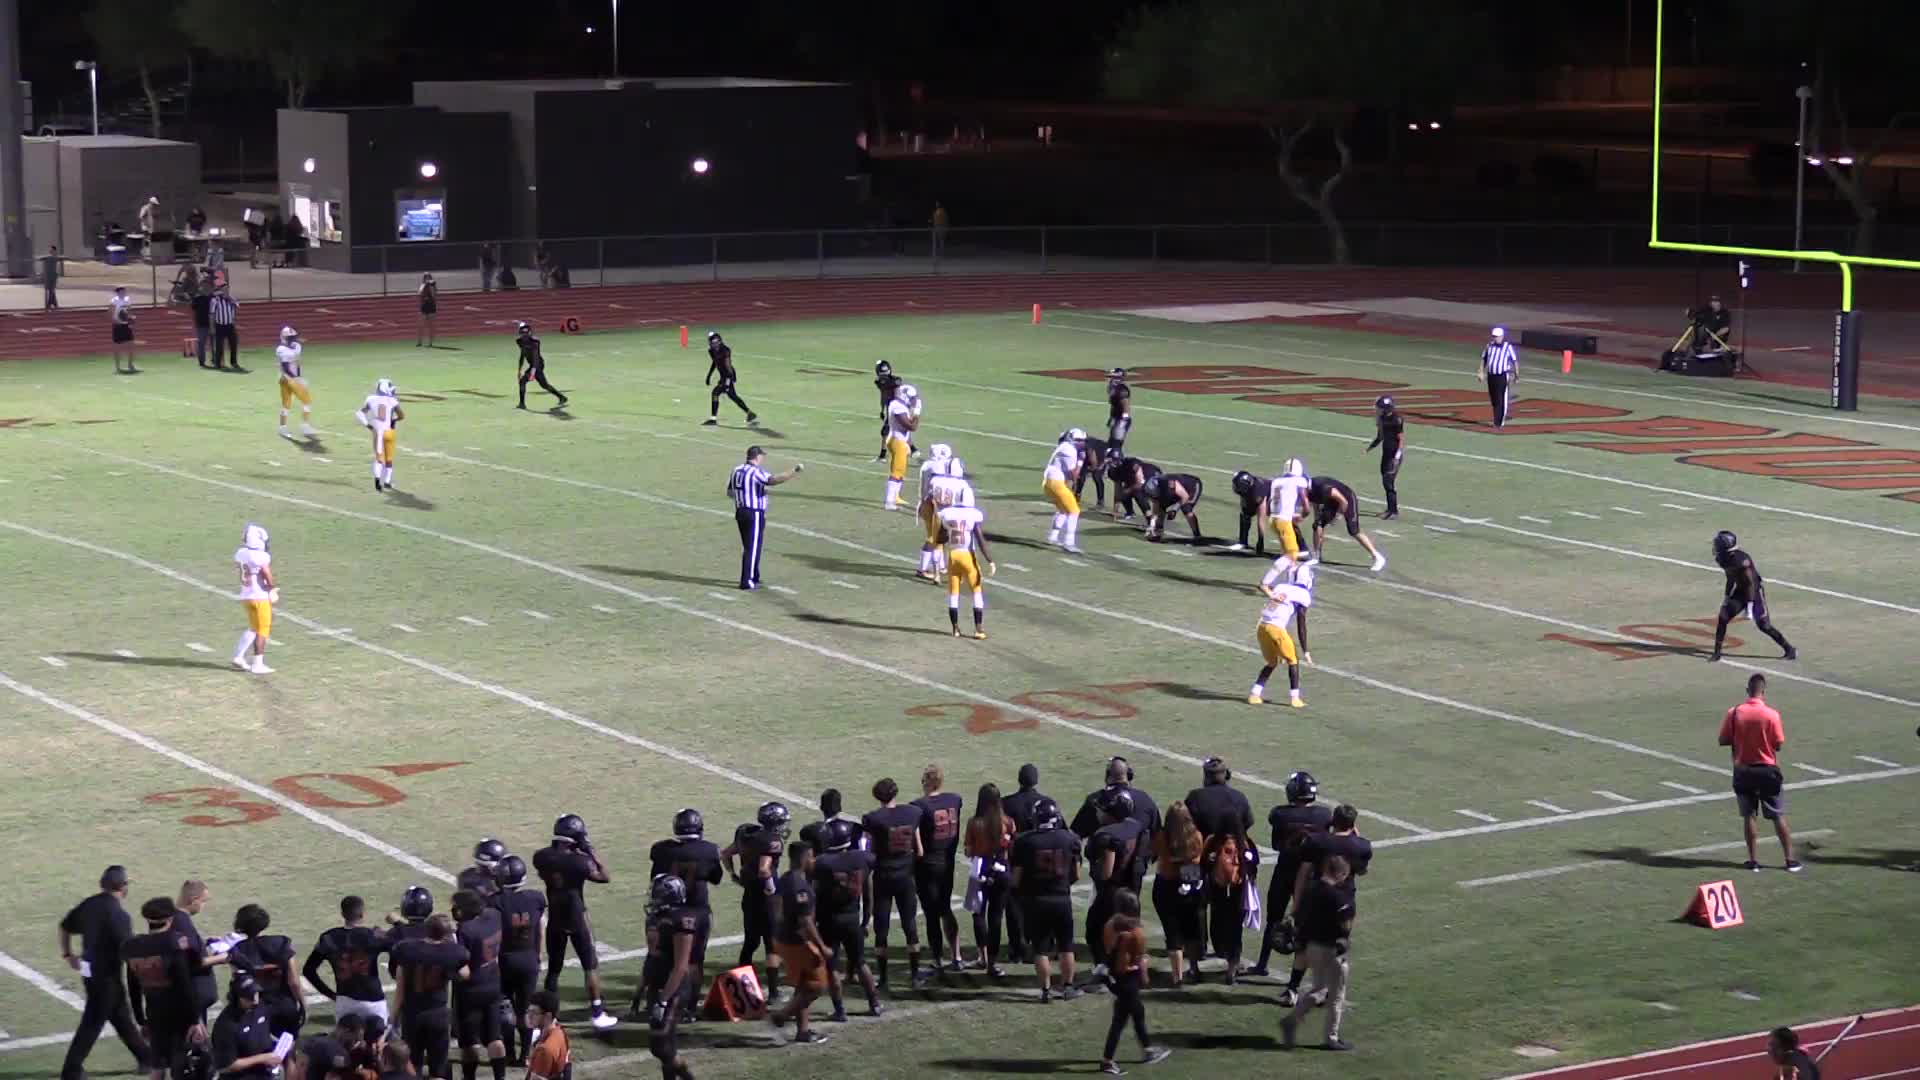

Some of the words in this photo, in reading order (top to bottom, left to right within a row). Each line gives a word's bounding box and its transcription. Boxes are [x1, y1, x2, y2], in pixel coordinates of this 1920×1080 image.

[567, 318, 579, 332] G
[1537, 623, 1745, 662] 10
[904, 690, 1140, 736] 20
[144, 776, 408, 828] 30
[1708, 884, 1737, 923] 20
